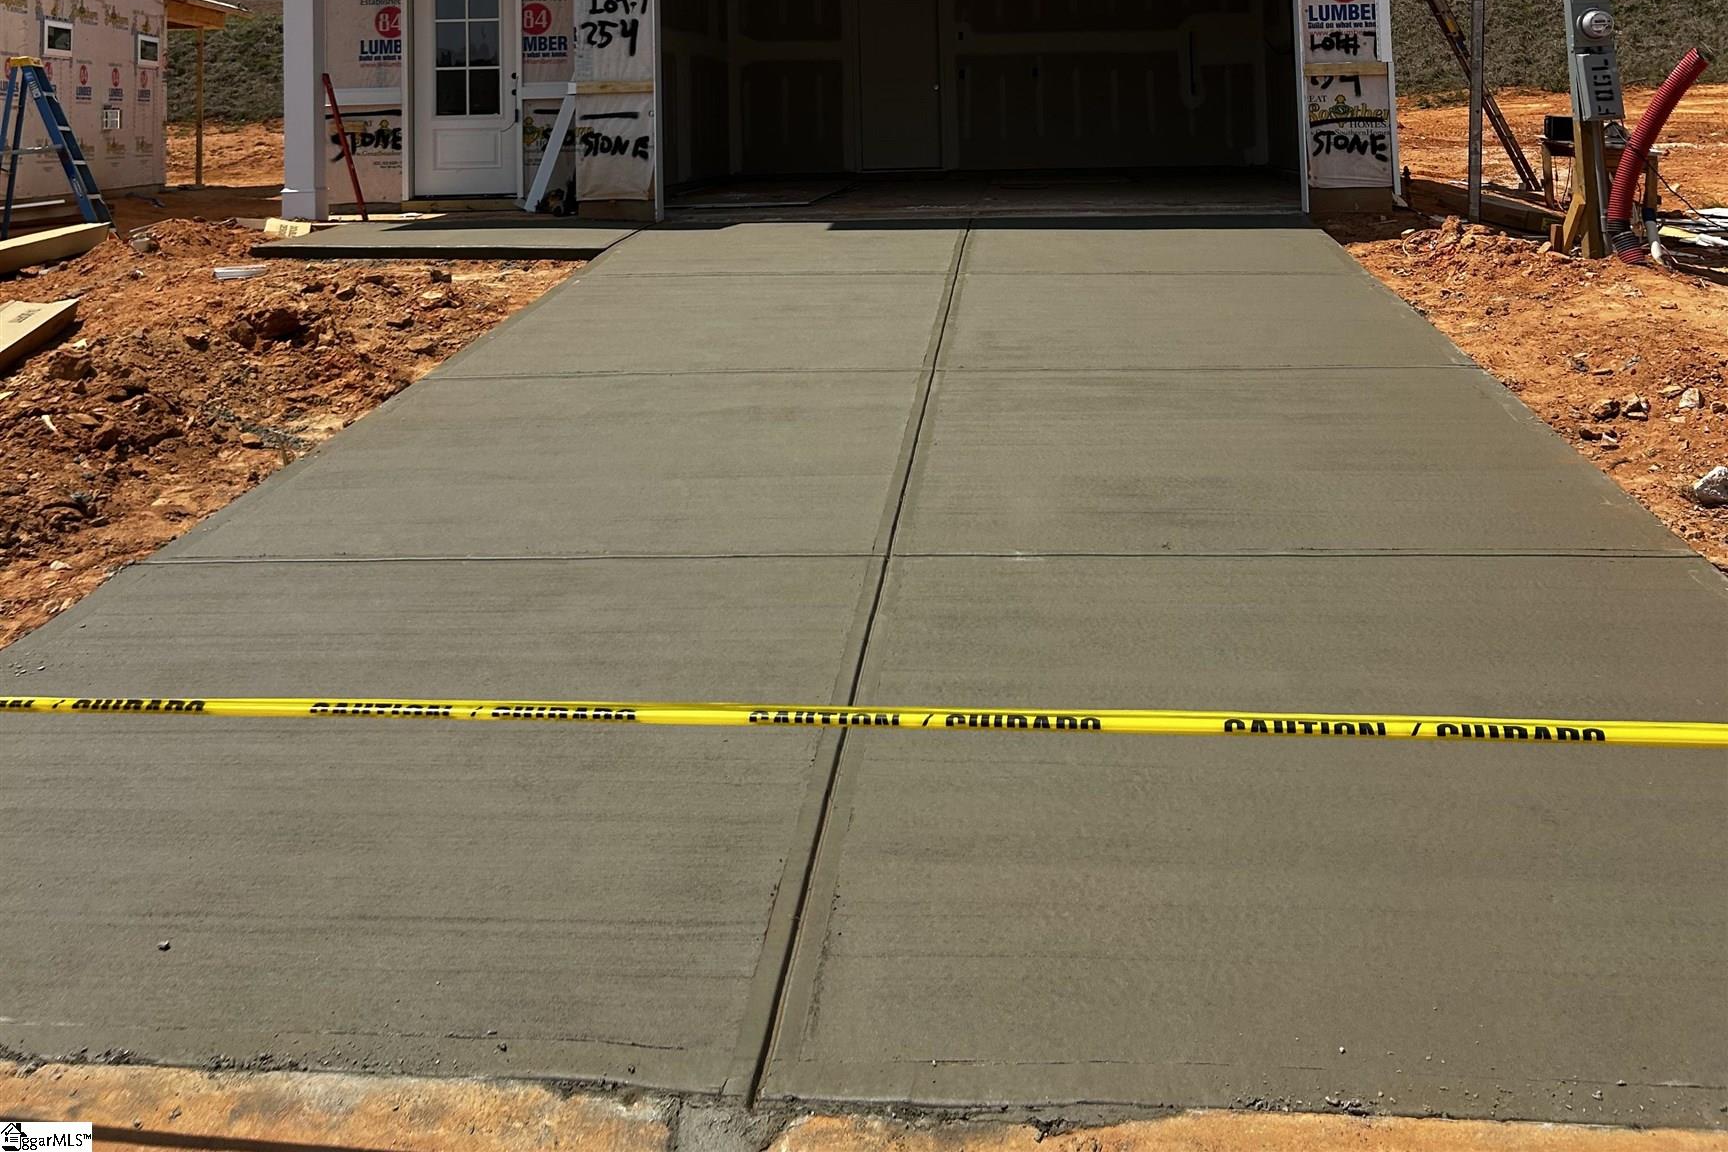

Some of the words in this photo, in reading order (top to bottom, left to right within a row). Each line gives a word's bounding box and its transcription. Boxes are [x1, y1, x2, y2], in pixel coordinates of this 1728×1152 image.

[523, 36, 568, 52] MBER
[580, 19, 639, 56] 254
[1312, 131, 1388, 162] STONE
